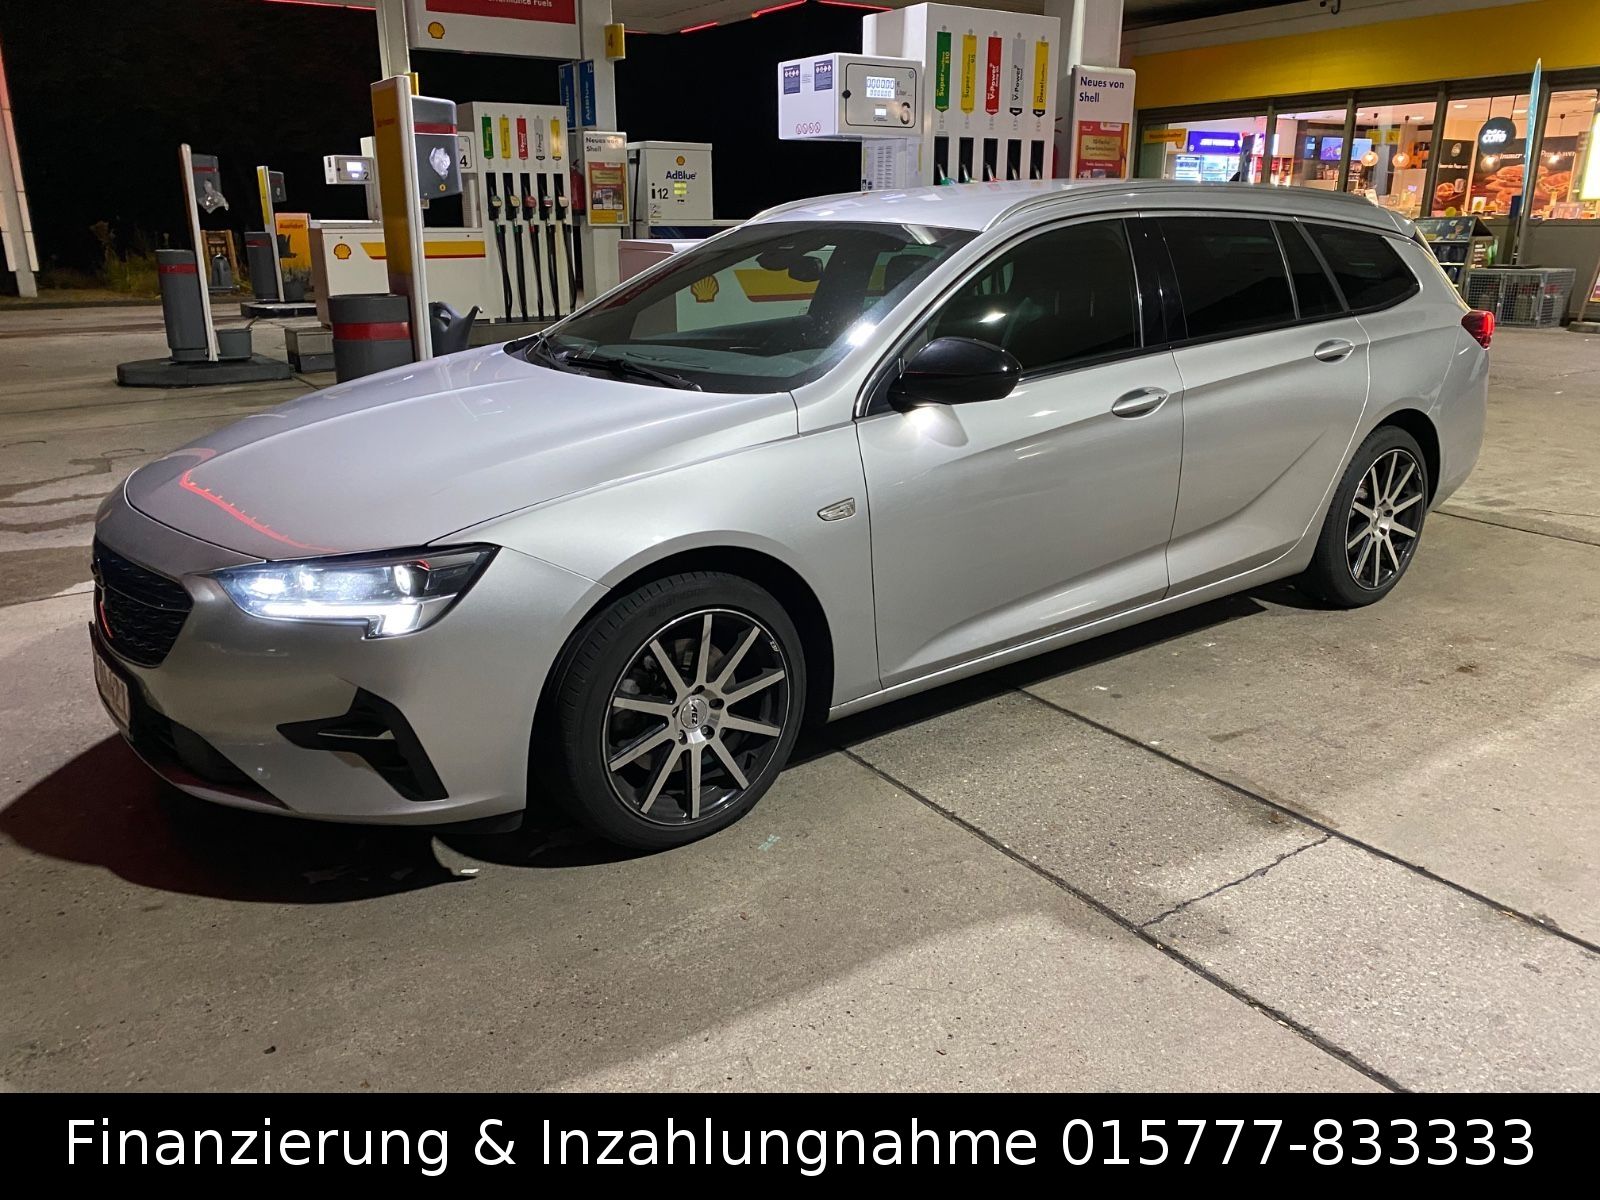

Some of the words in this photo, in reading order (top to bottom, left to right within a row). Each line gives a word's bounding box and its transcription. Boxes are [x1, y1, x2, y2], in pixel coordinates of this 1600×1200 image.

[1080, 77, 1107, 88] Neues
[1109, 81, 1125, 89] von
[1079, 92, 1100, 102] Shell
[900, 102, 911, 124] 6
[460, 155, 468, 167] 4
[665, 171, 697, 180] AdBlue
